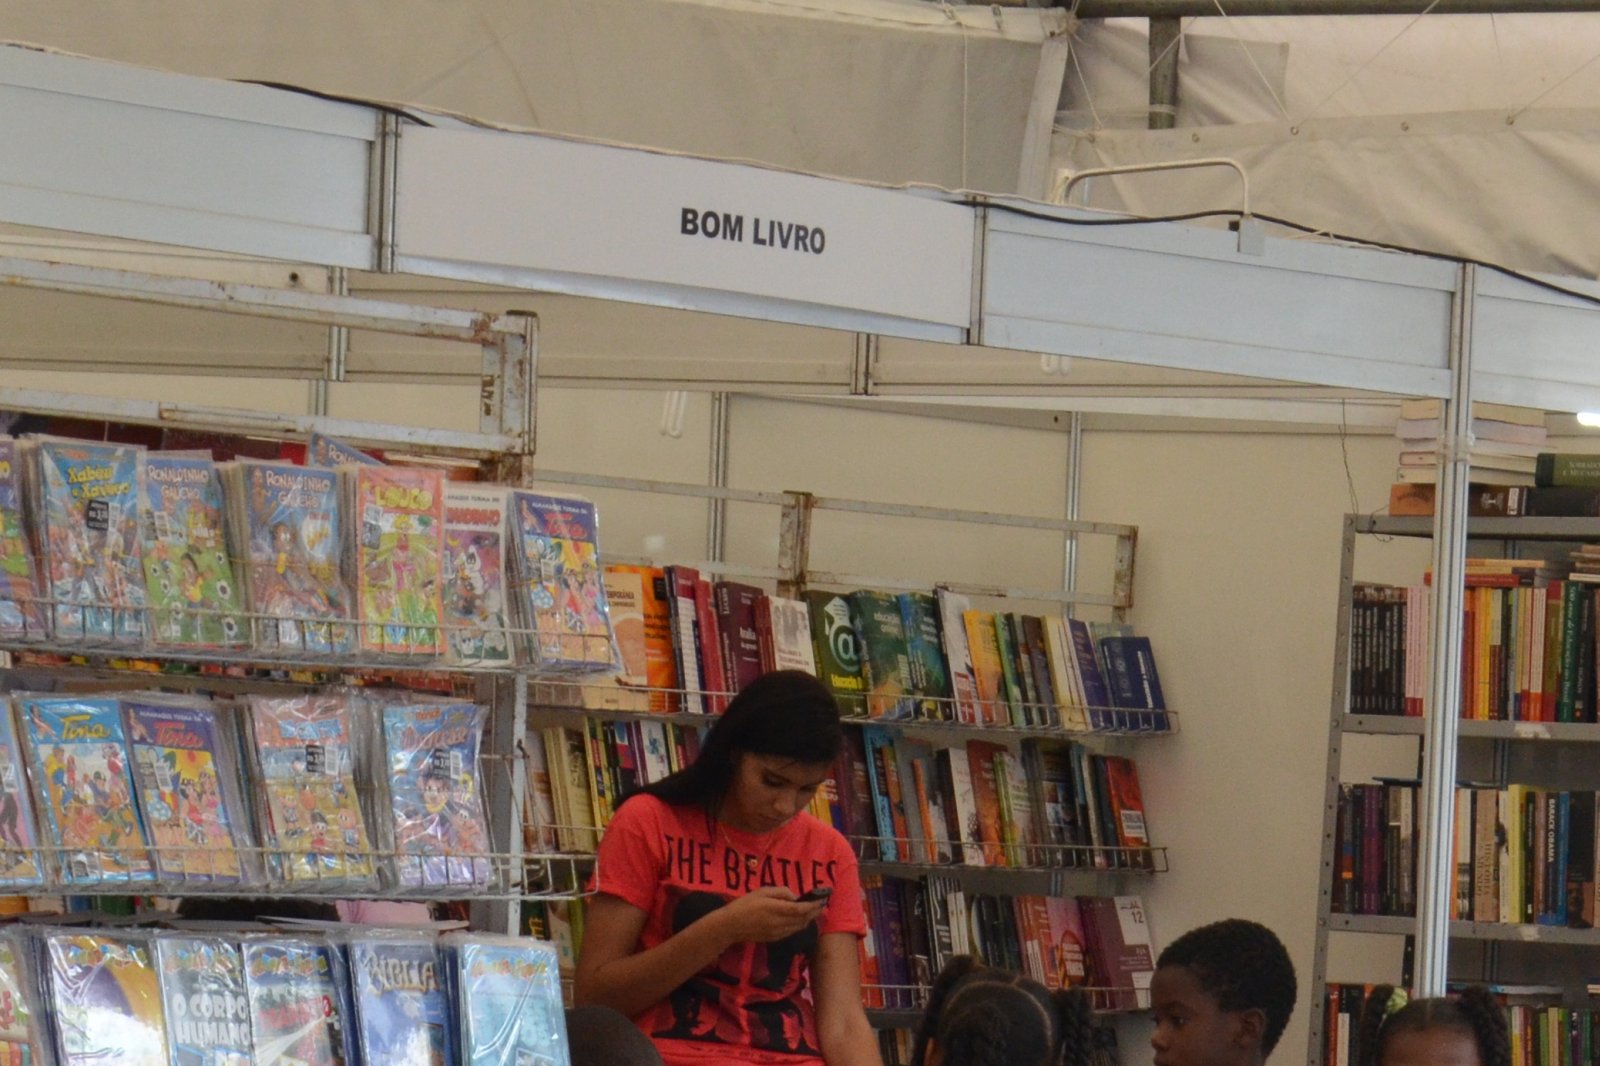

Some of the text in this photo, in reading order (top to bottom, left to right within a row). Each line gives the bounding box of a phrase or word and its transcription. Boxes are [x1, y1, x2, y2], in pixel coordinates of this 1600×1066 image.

[680, 207, 826, 254] BOM LIVRO
[1547, 798, 1556, 863] BARACK OBAMA
[664, 834, 713, 885] THE
[172, 992, 187, 1017] O
[189, 991, 249, 1019] CORPO
[174, 1020, 250, 1046] HUMANO
